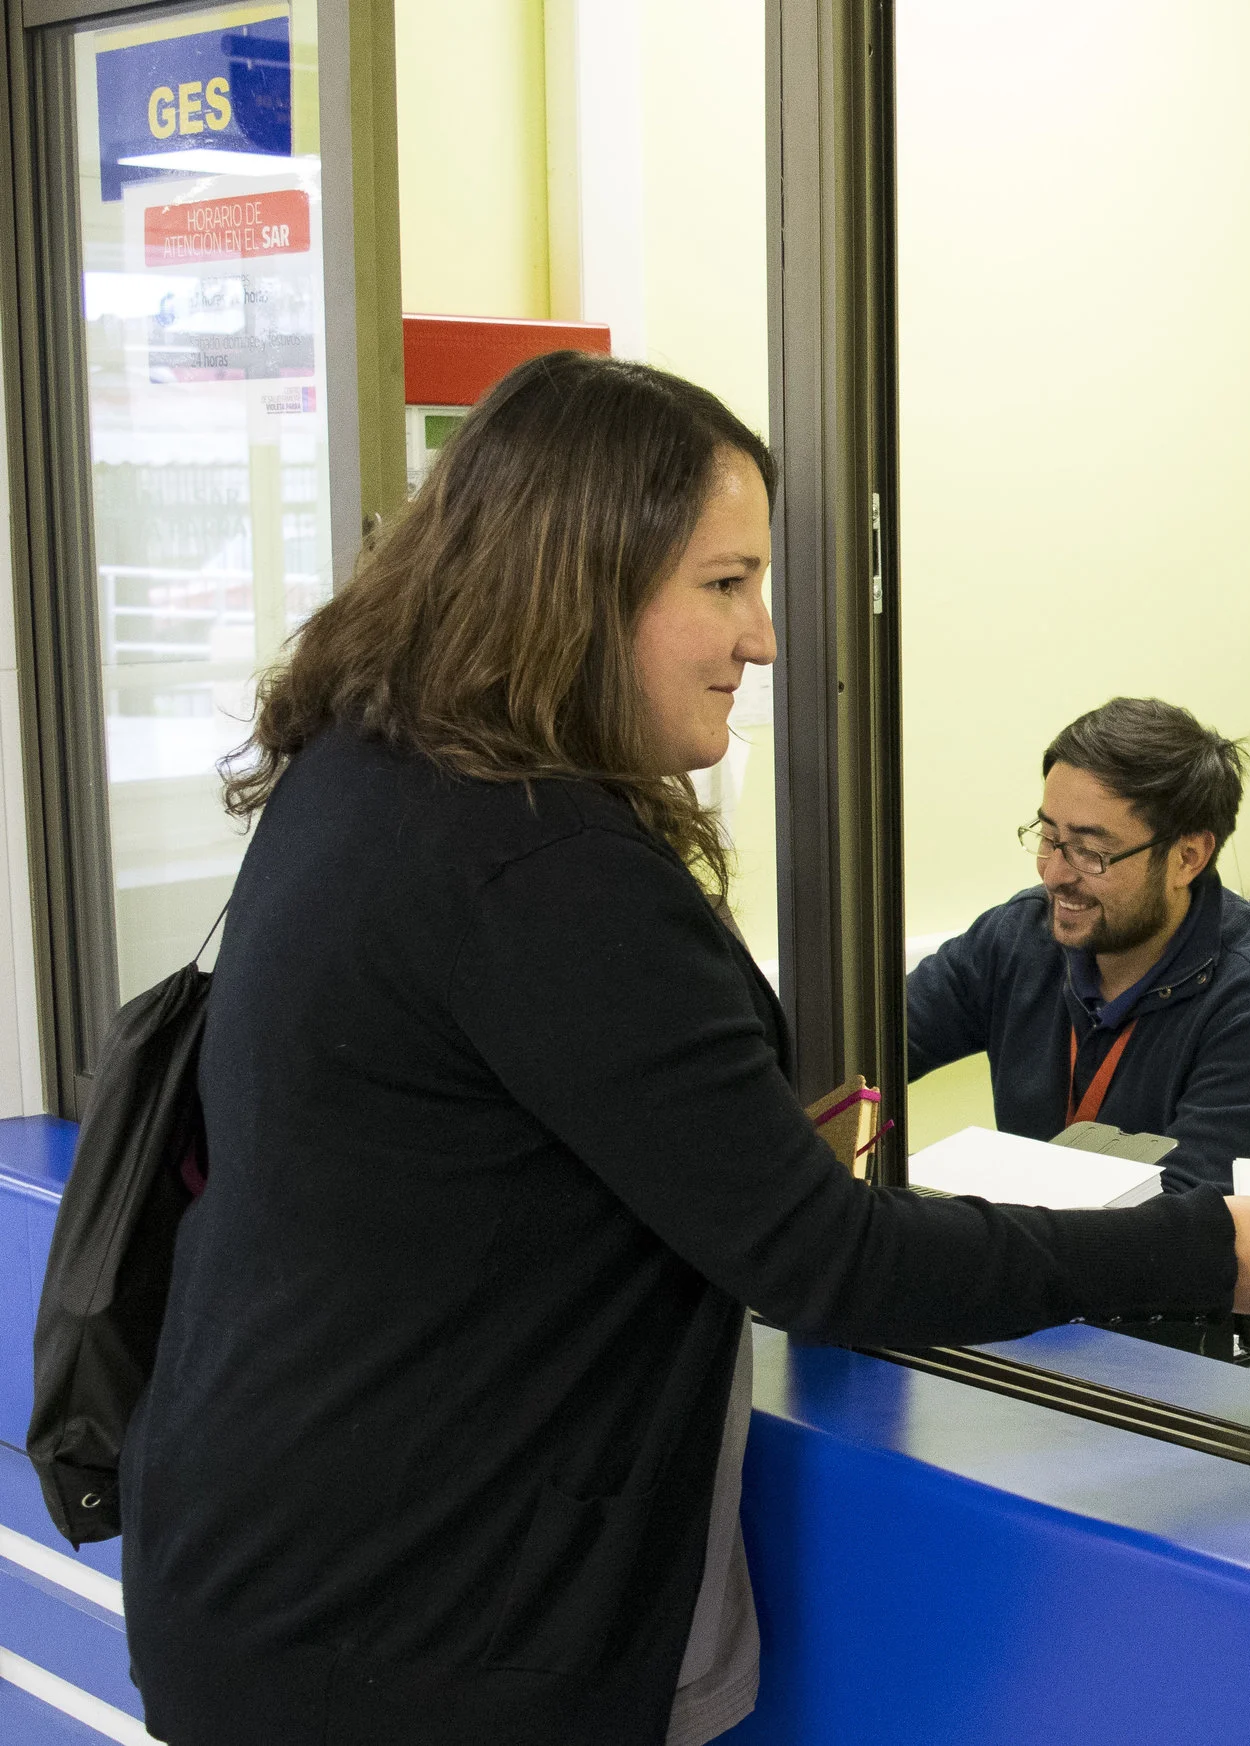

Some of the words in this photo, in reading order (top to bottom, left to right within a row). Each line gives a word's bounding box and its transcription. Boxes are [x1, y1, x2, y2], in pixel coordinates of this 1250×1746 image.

[148, 76, 231, 139] GES
[187, 204, 243, 231] HORARIO
[246, 202, 263, 226] DE
[163, 231, 222, 258] ATENCIÓN
[225, 230, 241, 252] EN
[245, 229, 259, 250] EL
[261, 224, 290, 249] SAR
[204, 352, 228, 367] horas
